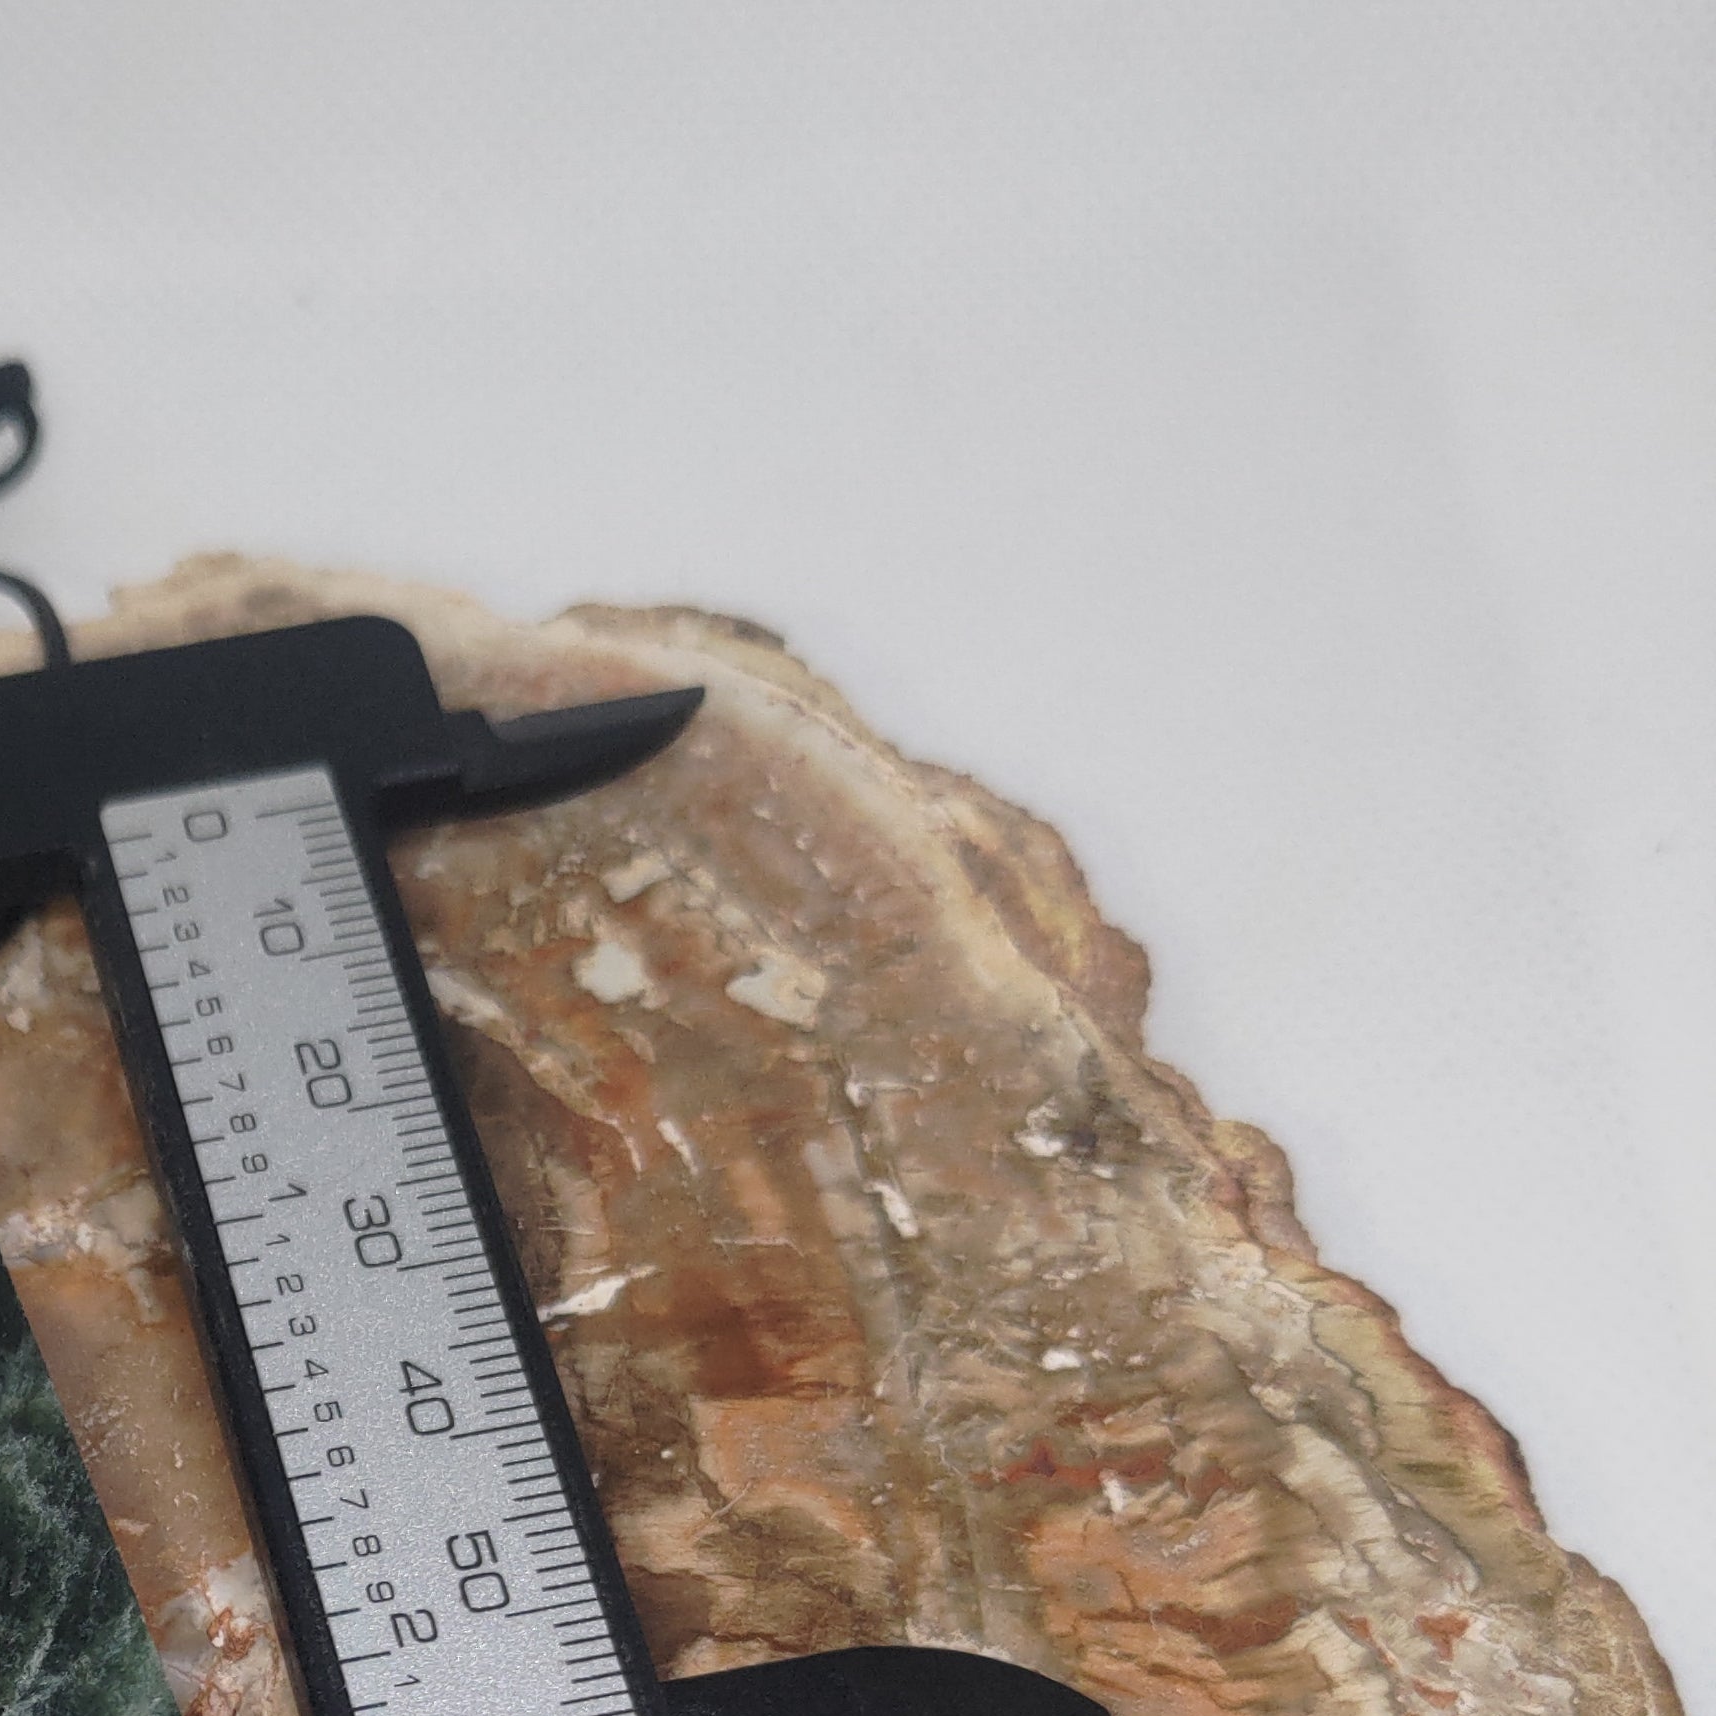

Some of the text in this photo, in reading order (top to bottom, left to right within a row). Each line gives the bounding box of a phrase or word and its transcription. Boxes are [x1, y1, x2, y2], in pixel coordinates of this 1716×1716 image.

[154, 851, 178, 864] 1
[162, 885, 190, 907] 2
[173, 920, 200, 943] 3
[187, 959, 211, 980] 4
[195, 996, 223, 1018] 5
[206, 1034, 233, 1056] 6
[218, 1072, 247, 1094] 7
[229, 1112, 257, 1134] 8
[241, 1152, 269, 1175] 9
[267, 1181, 308, 1202] 1
[184, 810, 228, 843] 0
[253, 897, 305, 957] 10
[294, 1038, 353, 1110] 20
[342, 1194, 403, 1269] 30
[398, 1359, 456, 1437] 40
[445, 1528, 511, 1613] 50
[265, 1233, 292, 1247] 1
[275, 1273, 305, 1297] 2
[287, 1314, 317, 1337] 3
[303, 1358, 330, 1381] 4
[312, 1400, 343, 1424] 5
[325, 1445, 356, 1469] 6
[339, 1488, 370, 1511] 7
[351, 1533, 383, 1558] 8
[365, 1579, 396, 1605] 9
[390, 1608, 440, 1649] 2
[392, 1673, 422, 1689] 1
